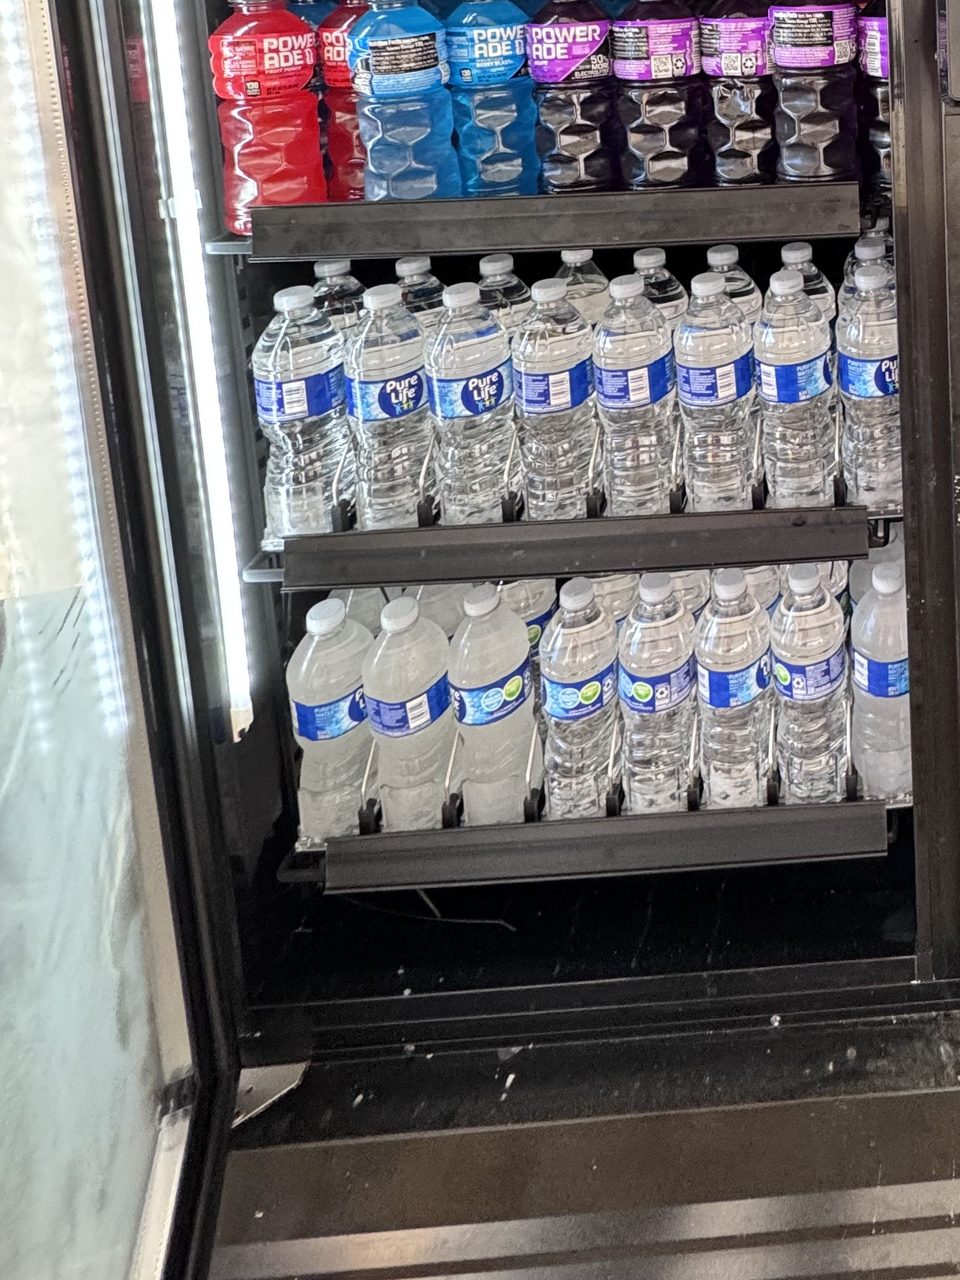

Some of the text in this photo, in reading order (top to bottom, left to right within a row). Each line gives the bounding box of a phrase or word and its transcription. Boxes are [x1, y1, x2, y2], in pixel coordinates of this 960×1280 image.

[263, 32, 315, 54] POWE
[473, 24, 525, 44] POWE
[532, 24, 600, 44] POWER
[474, 40, 512, 58] ADE
[532, 43, 568, 60] ADE
[264, 50, 304, 70] ADE
[882, 360, 896, 372] Pu
[386, 375, 418, 394] Pure
[468, 372, 498, 391] Pure
[390, 388, 417, 405] Life
[473, 385, 497, 402] Life
